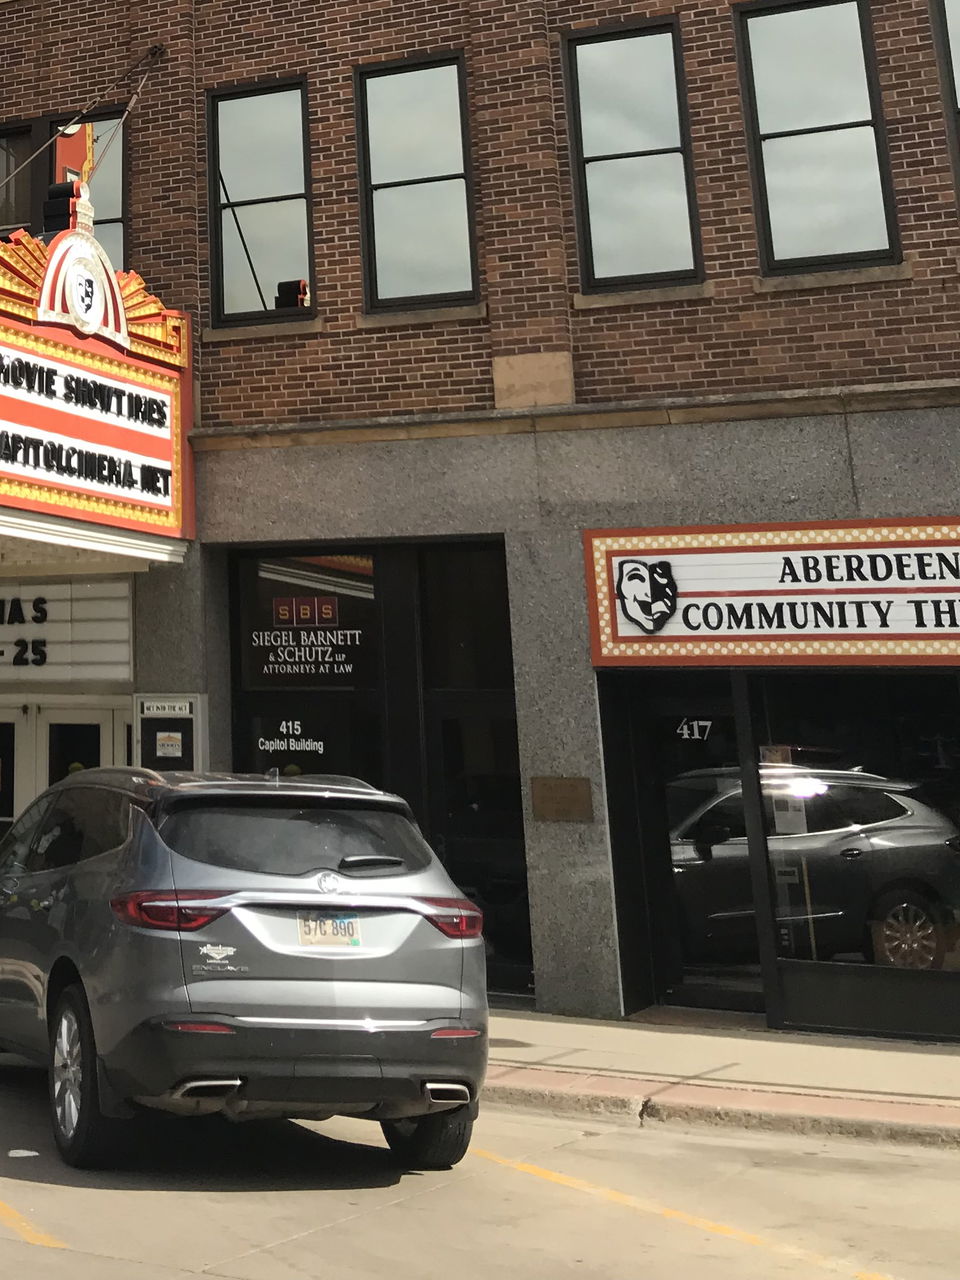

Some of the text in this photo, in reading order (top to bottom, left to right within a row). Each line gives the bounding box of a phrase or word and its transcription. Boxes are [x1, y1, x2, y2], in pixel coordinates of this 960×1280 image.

[778, 552, 960, 584] ABERDEEN
[682, 599, 960, 630] COMMUNITY TH
[252, 630, 362, 646] SIEGEL BARNETT
[269, 652, 275, 662] &
[277, 647, 333, 662] SCHUTZ
[263, 663, 353, 675] ATTORNEYS AT LAW
[280, 720, 301, 735] 415
[676, 718, 712, 741] 417
[258, 737, 324, 754] Capitol Building
[304, 918, 355, 937] 57C 890
